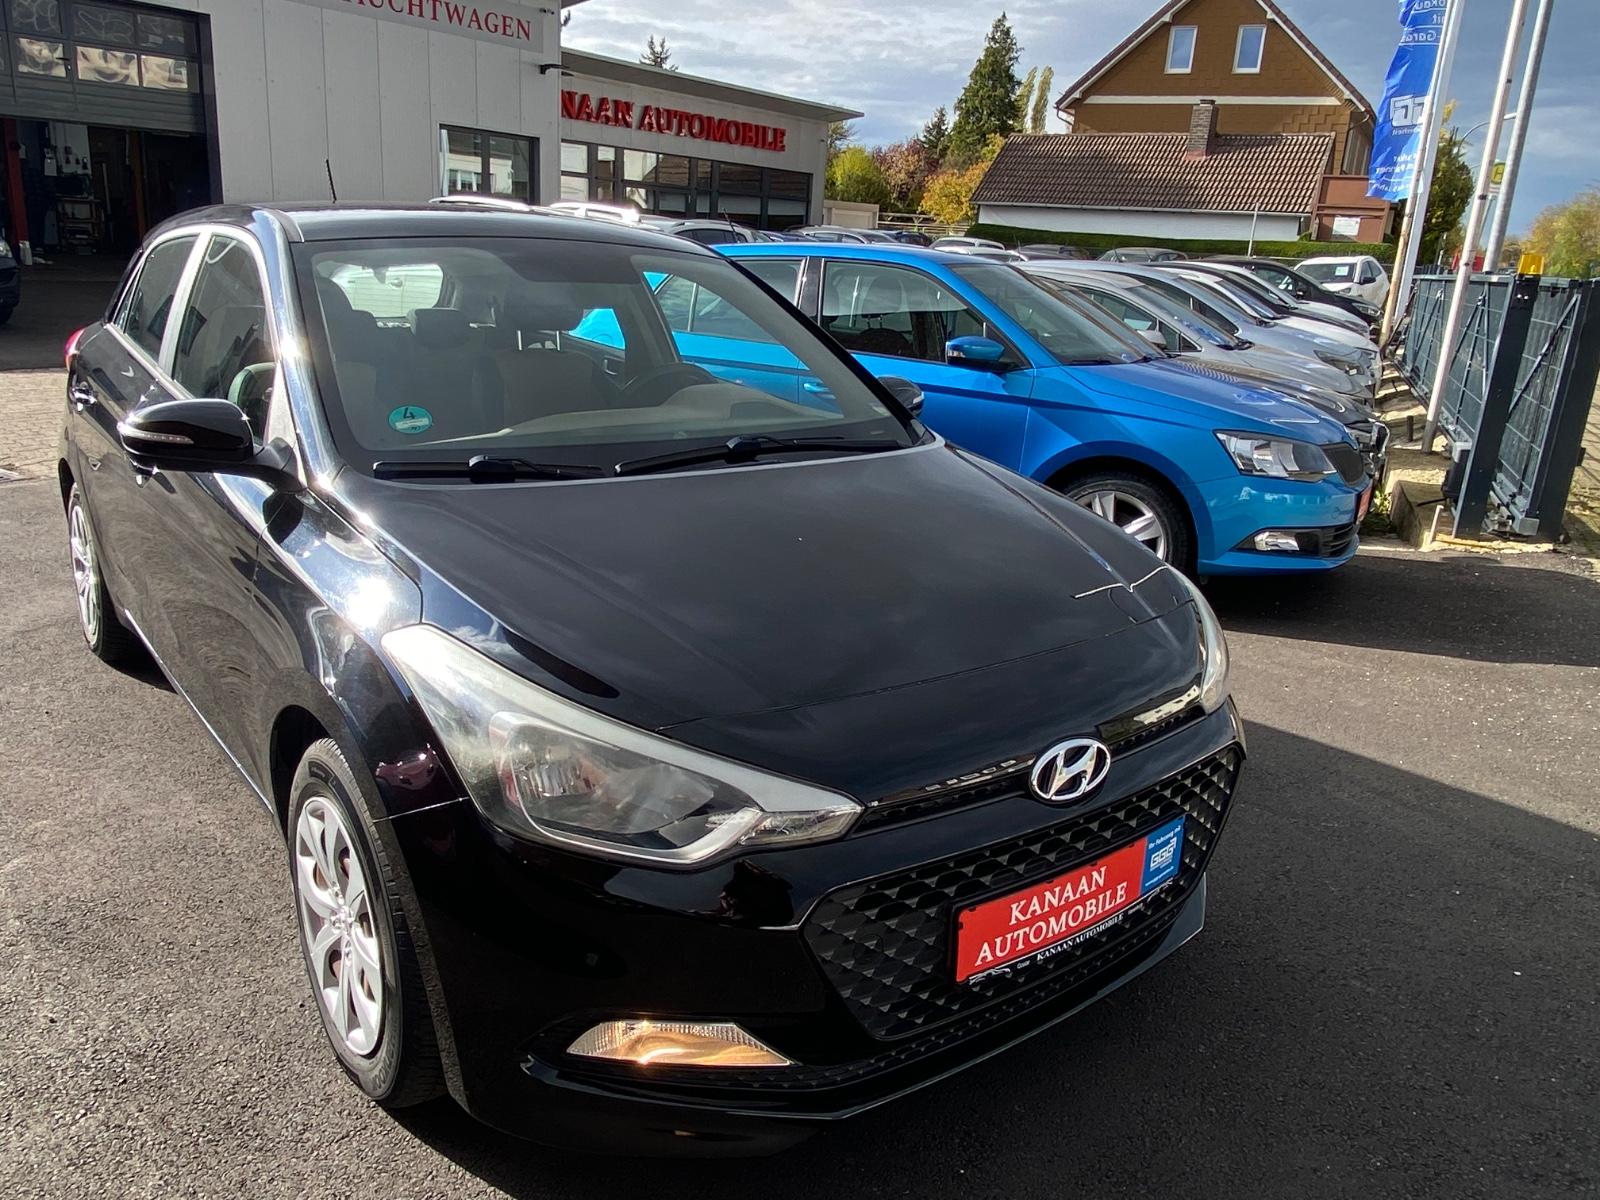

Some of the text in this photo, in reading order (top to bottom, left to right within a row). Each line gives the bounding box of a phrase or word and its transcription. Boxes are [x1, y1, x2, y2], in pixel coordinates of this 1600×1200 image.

[639, 104, 787, 152] AUTOMOBILE
[403, 407, 416, 419] 4
[1008, 866, 1108, 926] KANAAN
[974, 881, 1128, 967] AUTOMOBILE
[1036, 938, 1073, 961] KANAAN
[1074, 913, 1125, 943] AUTOMOBILE
